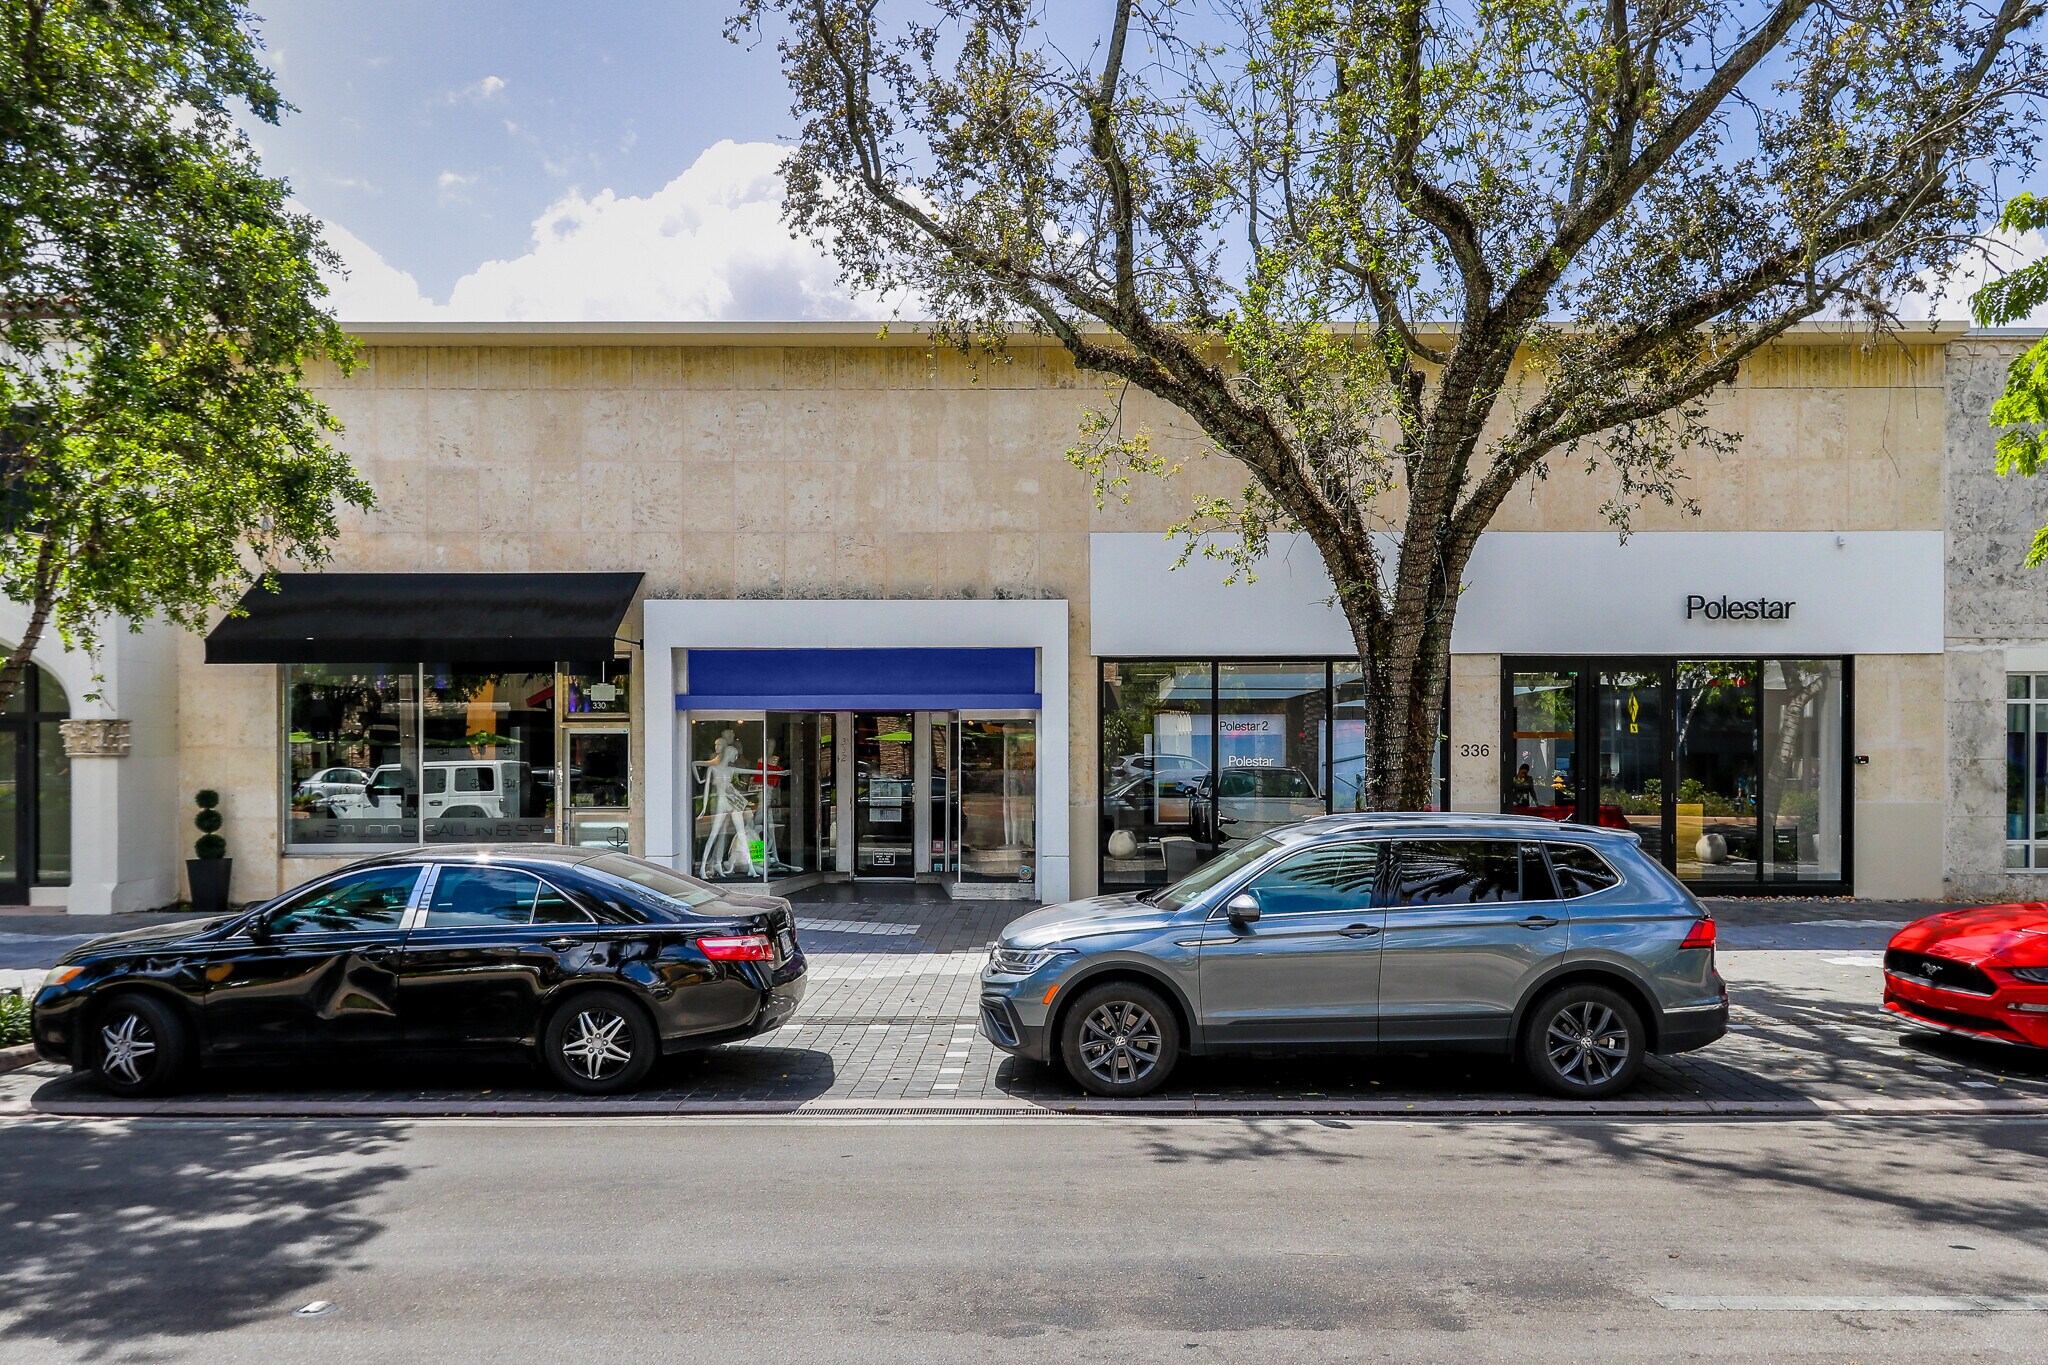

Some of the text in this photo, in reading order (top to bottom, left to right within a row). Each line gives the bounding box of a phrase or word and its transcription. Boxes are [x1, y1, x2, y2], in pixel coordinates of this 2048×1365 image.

[1686, 594, 1796, 620] Polestar
[592, 701, 607, 710] 330
[1219, 720, 1269, 732] Polestar 2
[1460, 743, 1490, 757] 336
[1228, 755, 1274, 767] Polestar
